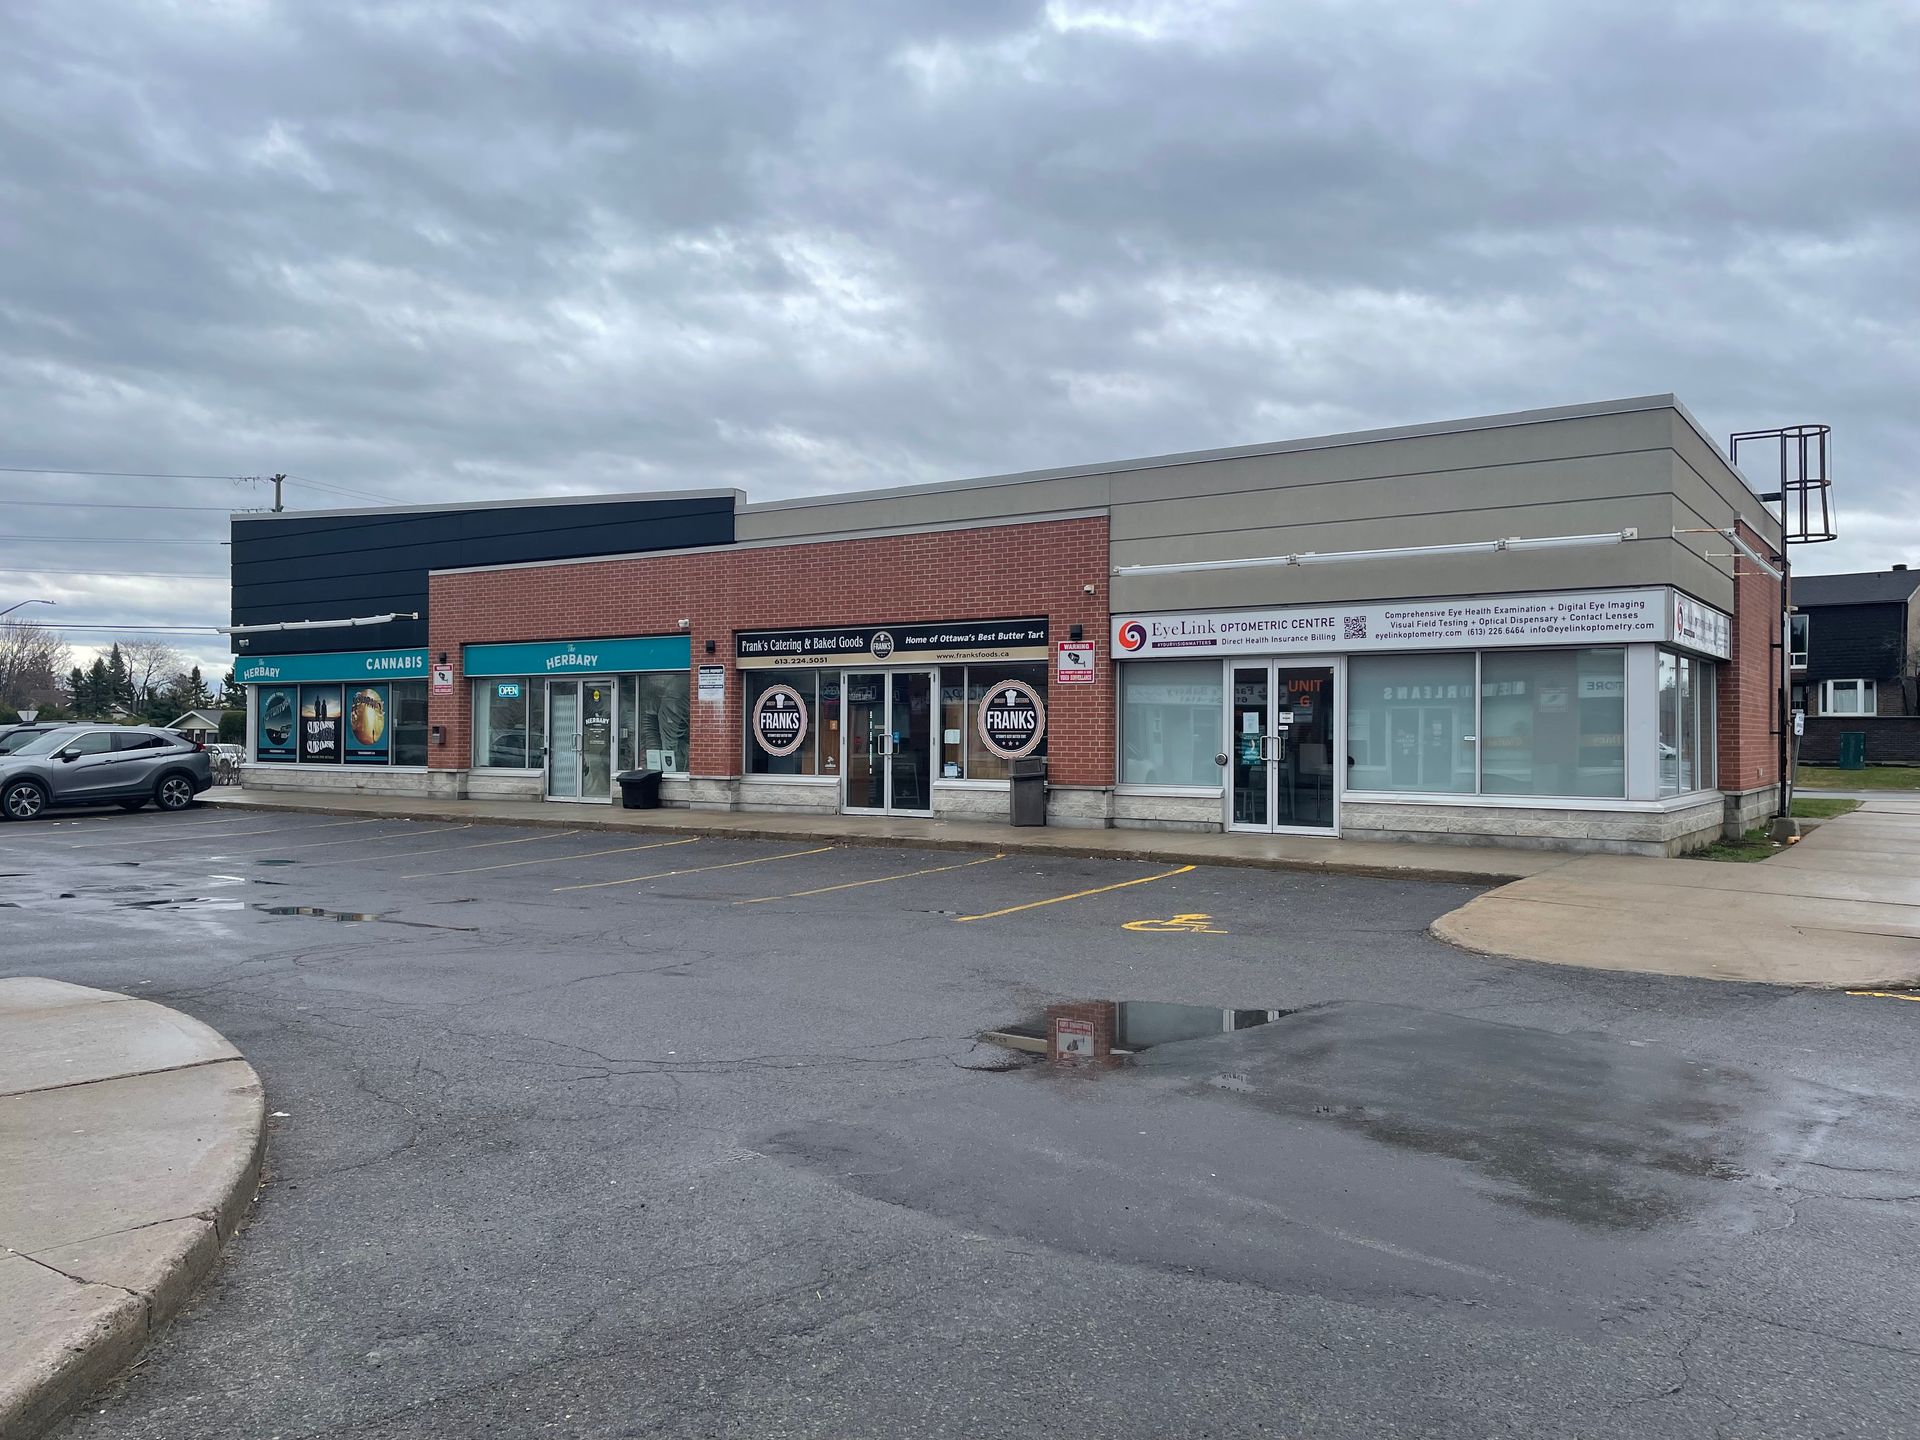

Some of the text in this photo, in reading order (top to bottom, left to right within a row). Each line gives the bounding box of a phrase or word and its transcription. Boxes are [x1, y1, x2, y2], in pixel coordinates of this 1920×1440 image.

[1385, 609, 1446, 620] Comprehensive
[1448, 608, 1463, 618] Eye
[1465, 606, 1491, 616] Health
[1494, 604, 1546, 615] Examination
[1558, 602, 1587, 613] Digital
[1589, 601, 1605, 611] Eye
[1608, 600, 1645, 610] Imaging
[1220, 616, 1336, 633] OPTOMETRIC CENTRE
[1390, 620, 1415, 629] Visual
[1417, 619, 1436, 628] Field
[1439, 618, 1468, 628] Testing
[1479, 616, 1507, 627] Optical
[1510, 614, 1559, 625] Dispensary
[1569, 612, 1602, 621] Contact
[1605, 611, 1639, 620] Lenses
[905, 630, 1044, 644] Home of Ottawa's Best Butter Tart
[1152, 619, 1217, 639] EyeLink
[1375, 629, 1462, 641] eyelinkoptometry.com
[1467, 628, 1486, 636] (613)
[1530, 621, 1655, 634] info@eyelinkoptometry.com
[741, 635, 864, 653] Frank's Catering & Baked Goods
[1221, 632, 1336, 646] Direct Health Insurance Billing
[366, 655, 422, 671] CANNABIS
[545, 653, 599, 670] HERBARY
[774, 657, 828, 665] 613.224.5051
[936, 651, 1010, 660] www.franksfoods.ca
[243, 666, 280, 680] HERBARY
[499, 685, 518, 696] OPEN
[1288, 679, 1324, 693] UNIT
[760, 712, 800, 729] FRANKS
[986, 710, 1035, 729] FRANKS
